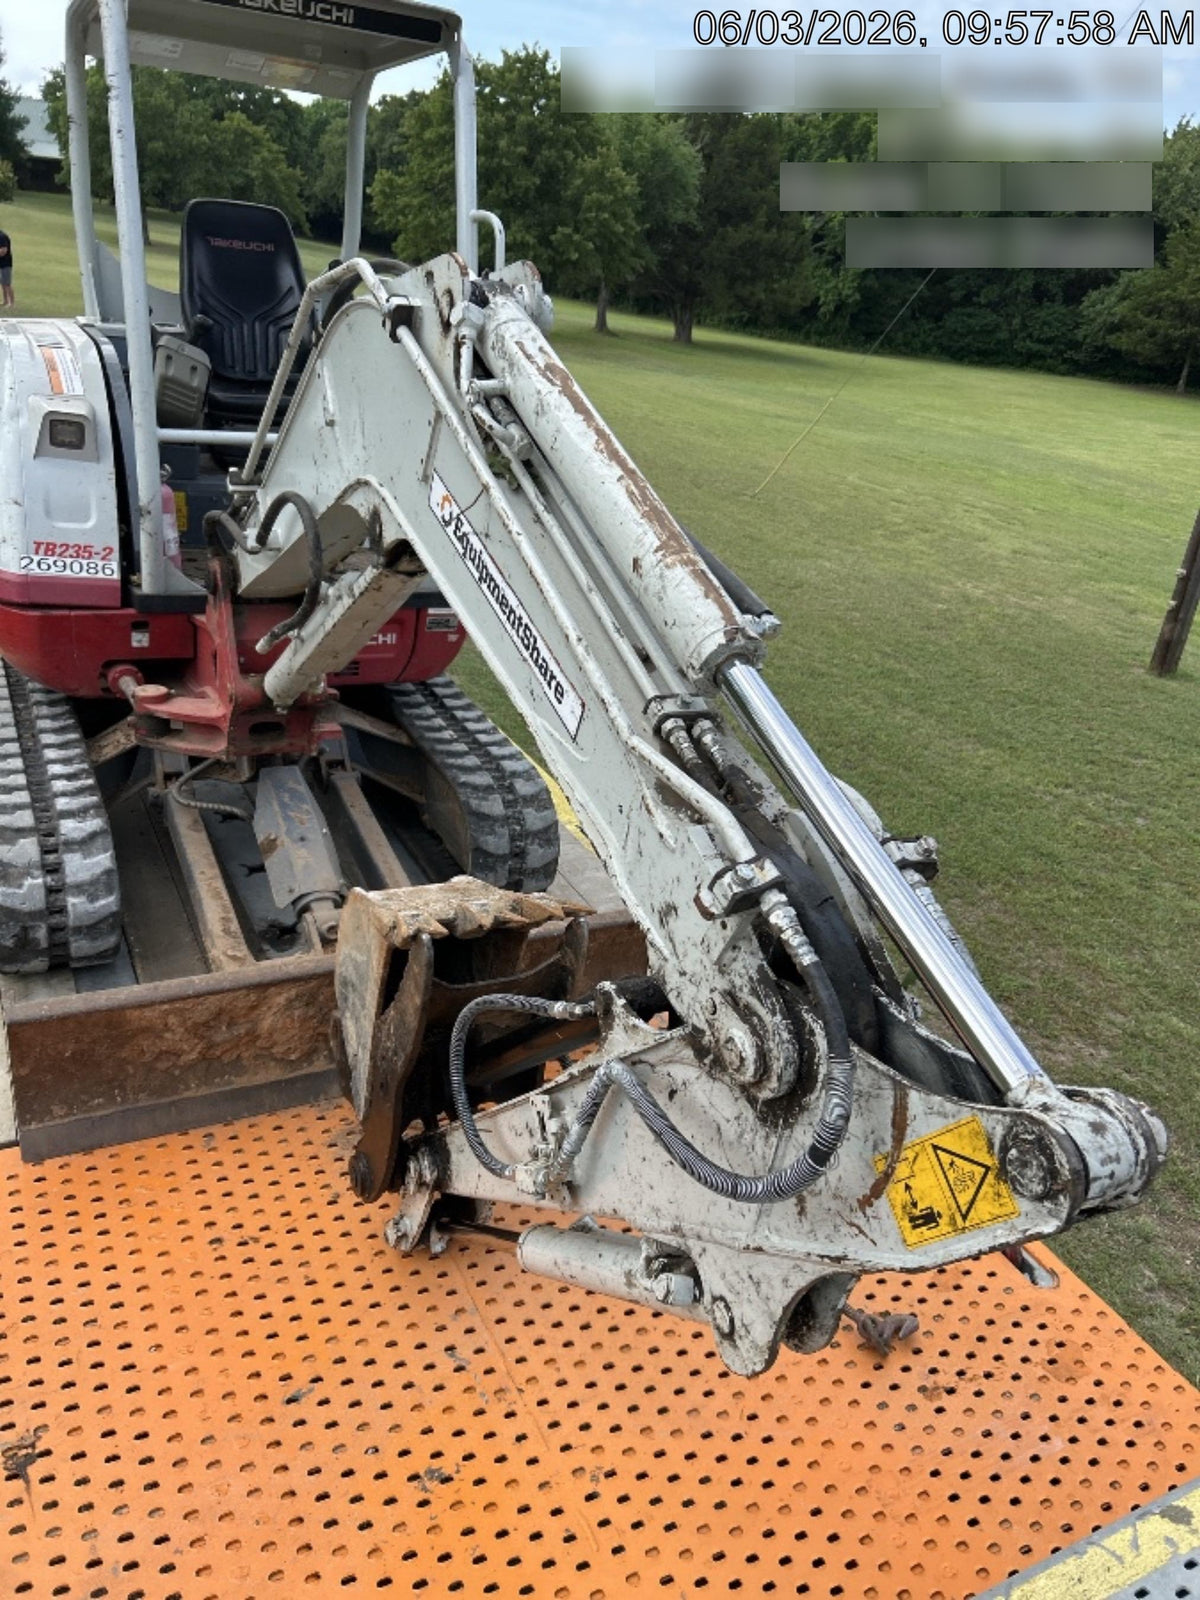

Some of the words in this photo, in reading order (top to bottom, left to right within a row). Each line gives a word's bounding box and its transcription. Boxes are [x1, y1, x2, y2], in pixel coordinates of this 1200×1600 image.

[33, 541, 114, 561] TB235-2
[20, 556, 115, 577] 269086
[452, 513, 566, 705] EquipmentShare
